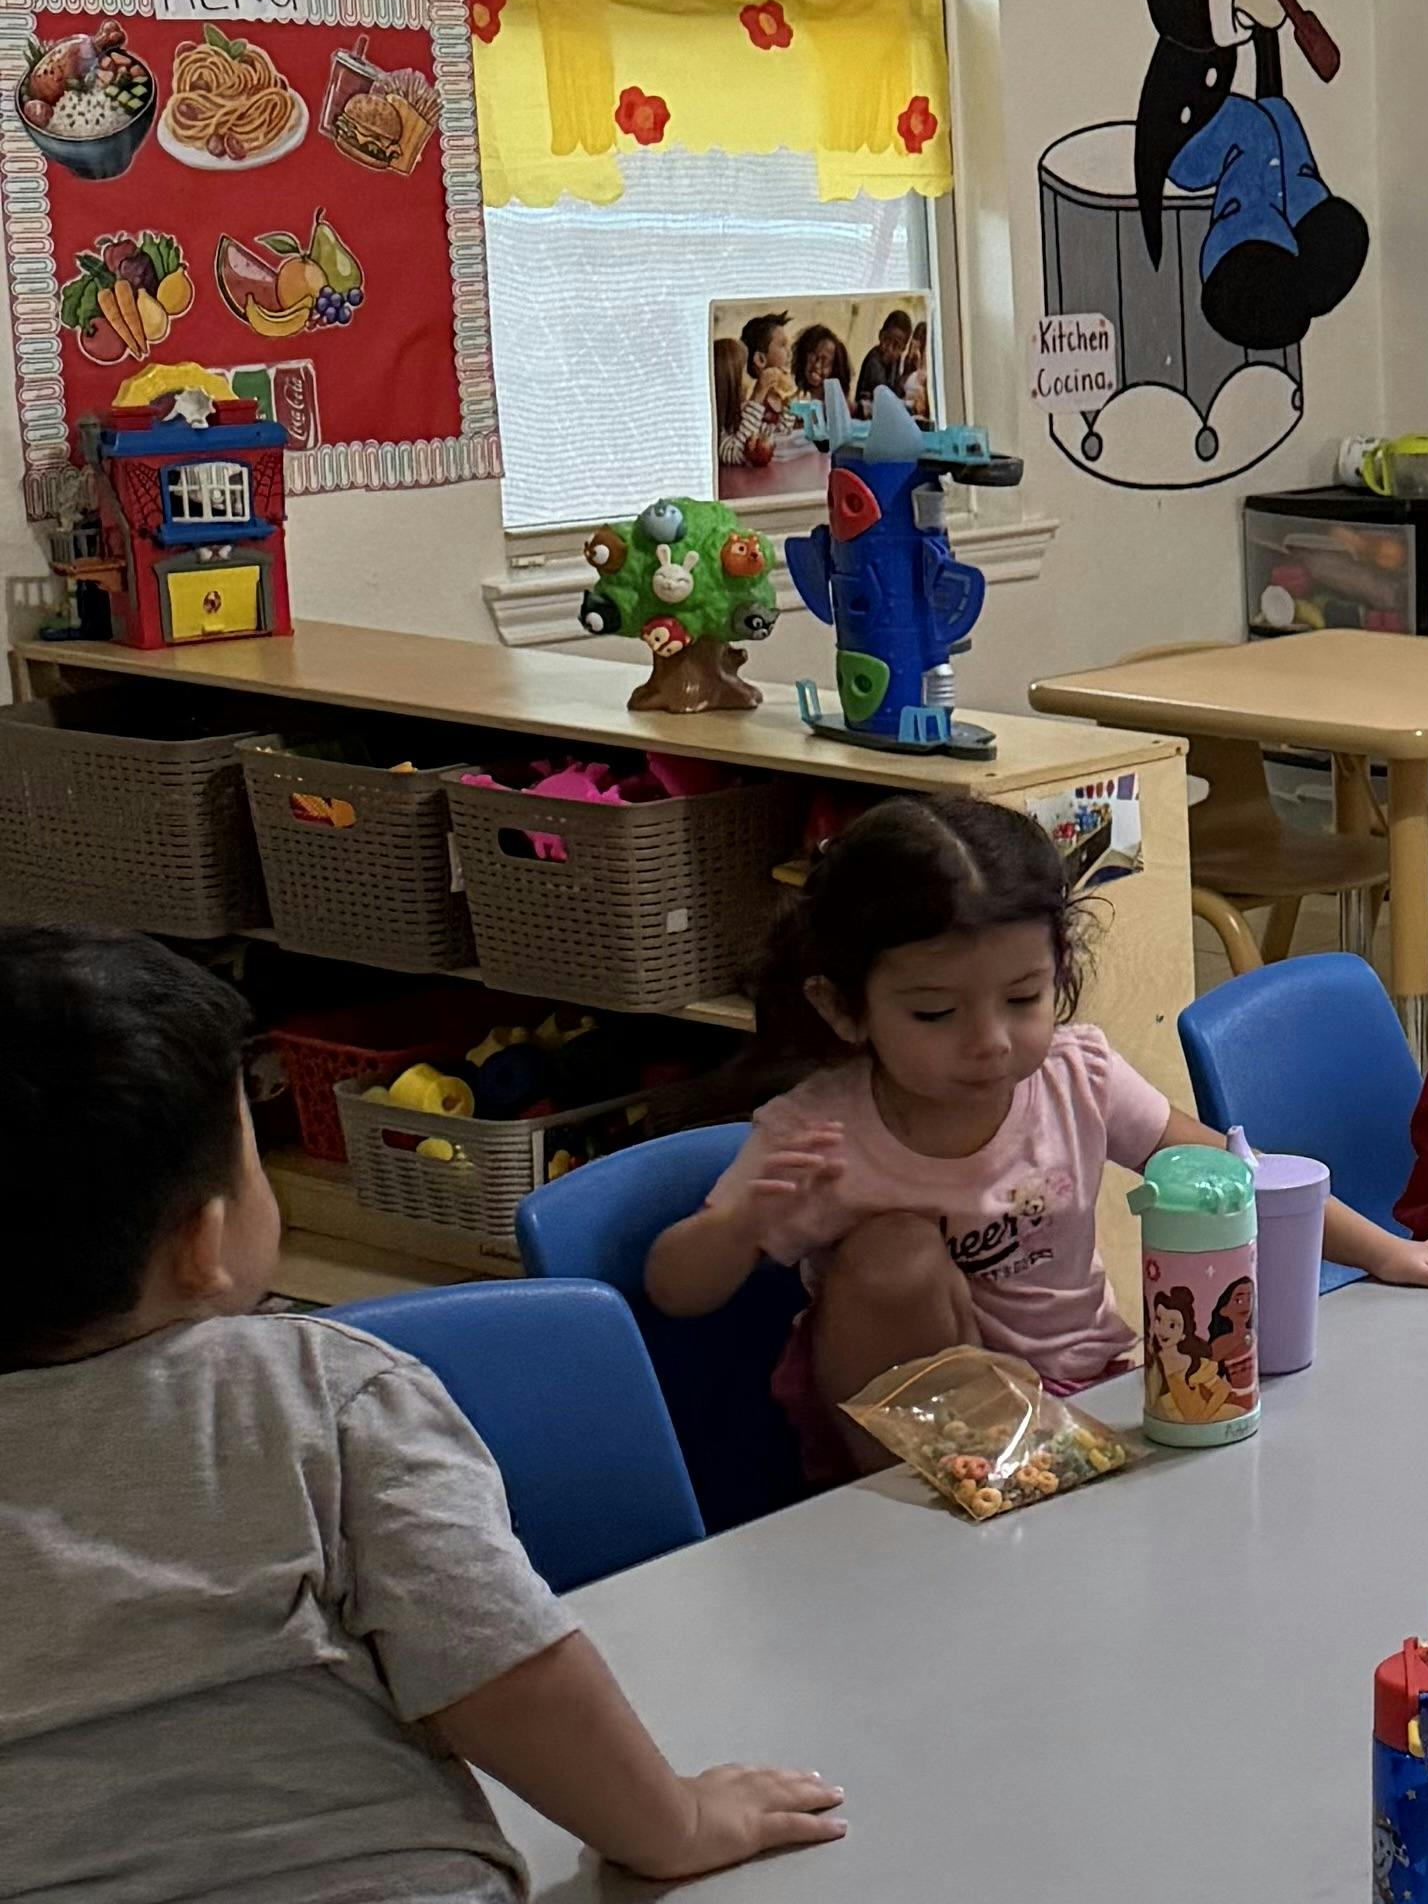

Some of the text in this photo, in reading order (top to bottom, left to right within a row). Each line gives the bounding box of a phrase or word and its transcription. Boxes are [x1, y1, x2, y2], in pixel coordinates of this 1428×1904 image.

[1038, 319, 1110, 355] Kitchen
[1036, 368, 1107, 397] Cocina
[938, 1212, 1018, 1261] heer
